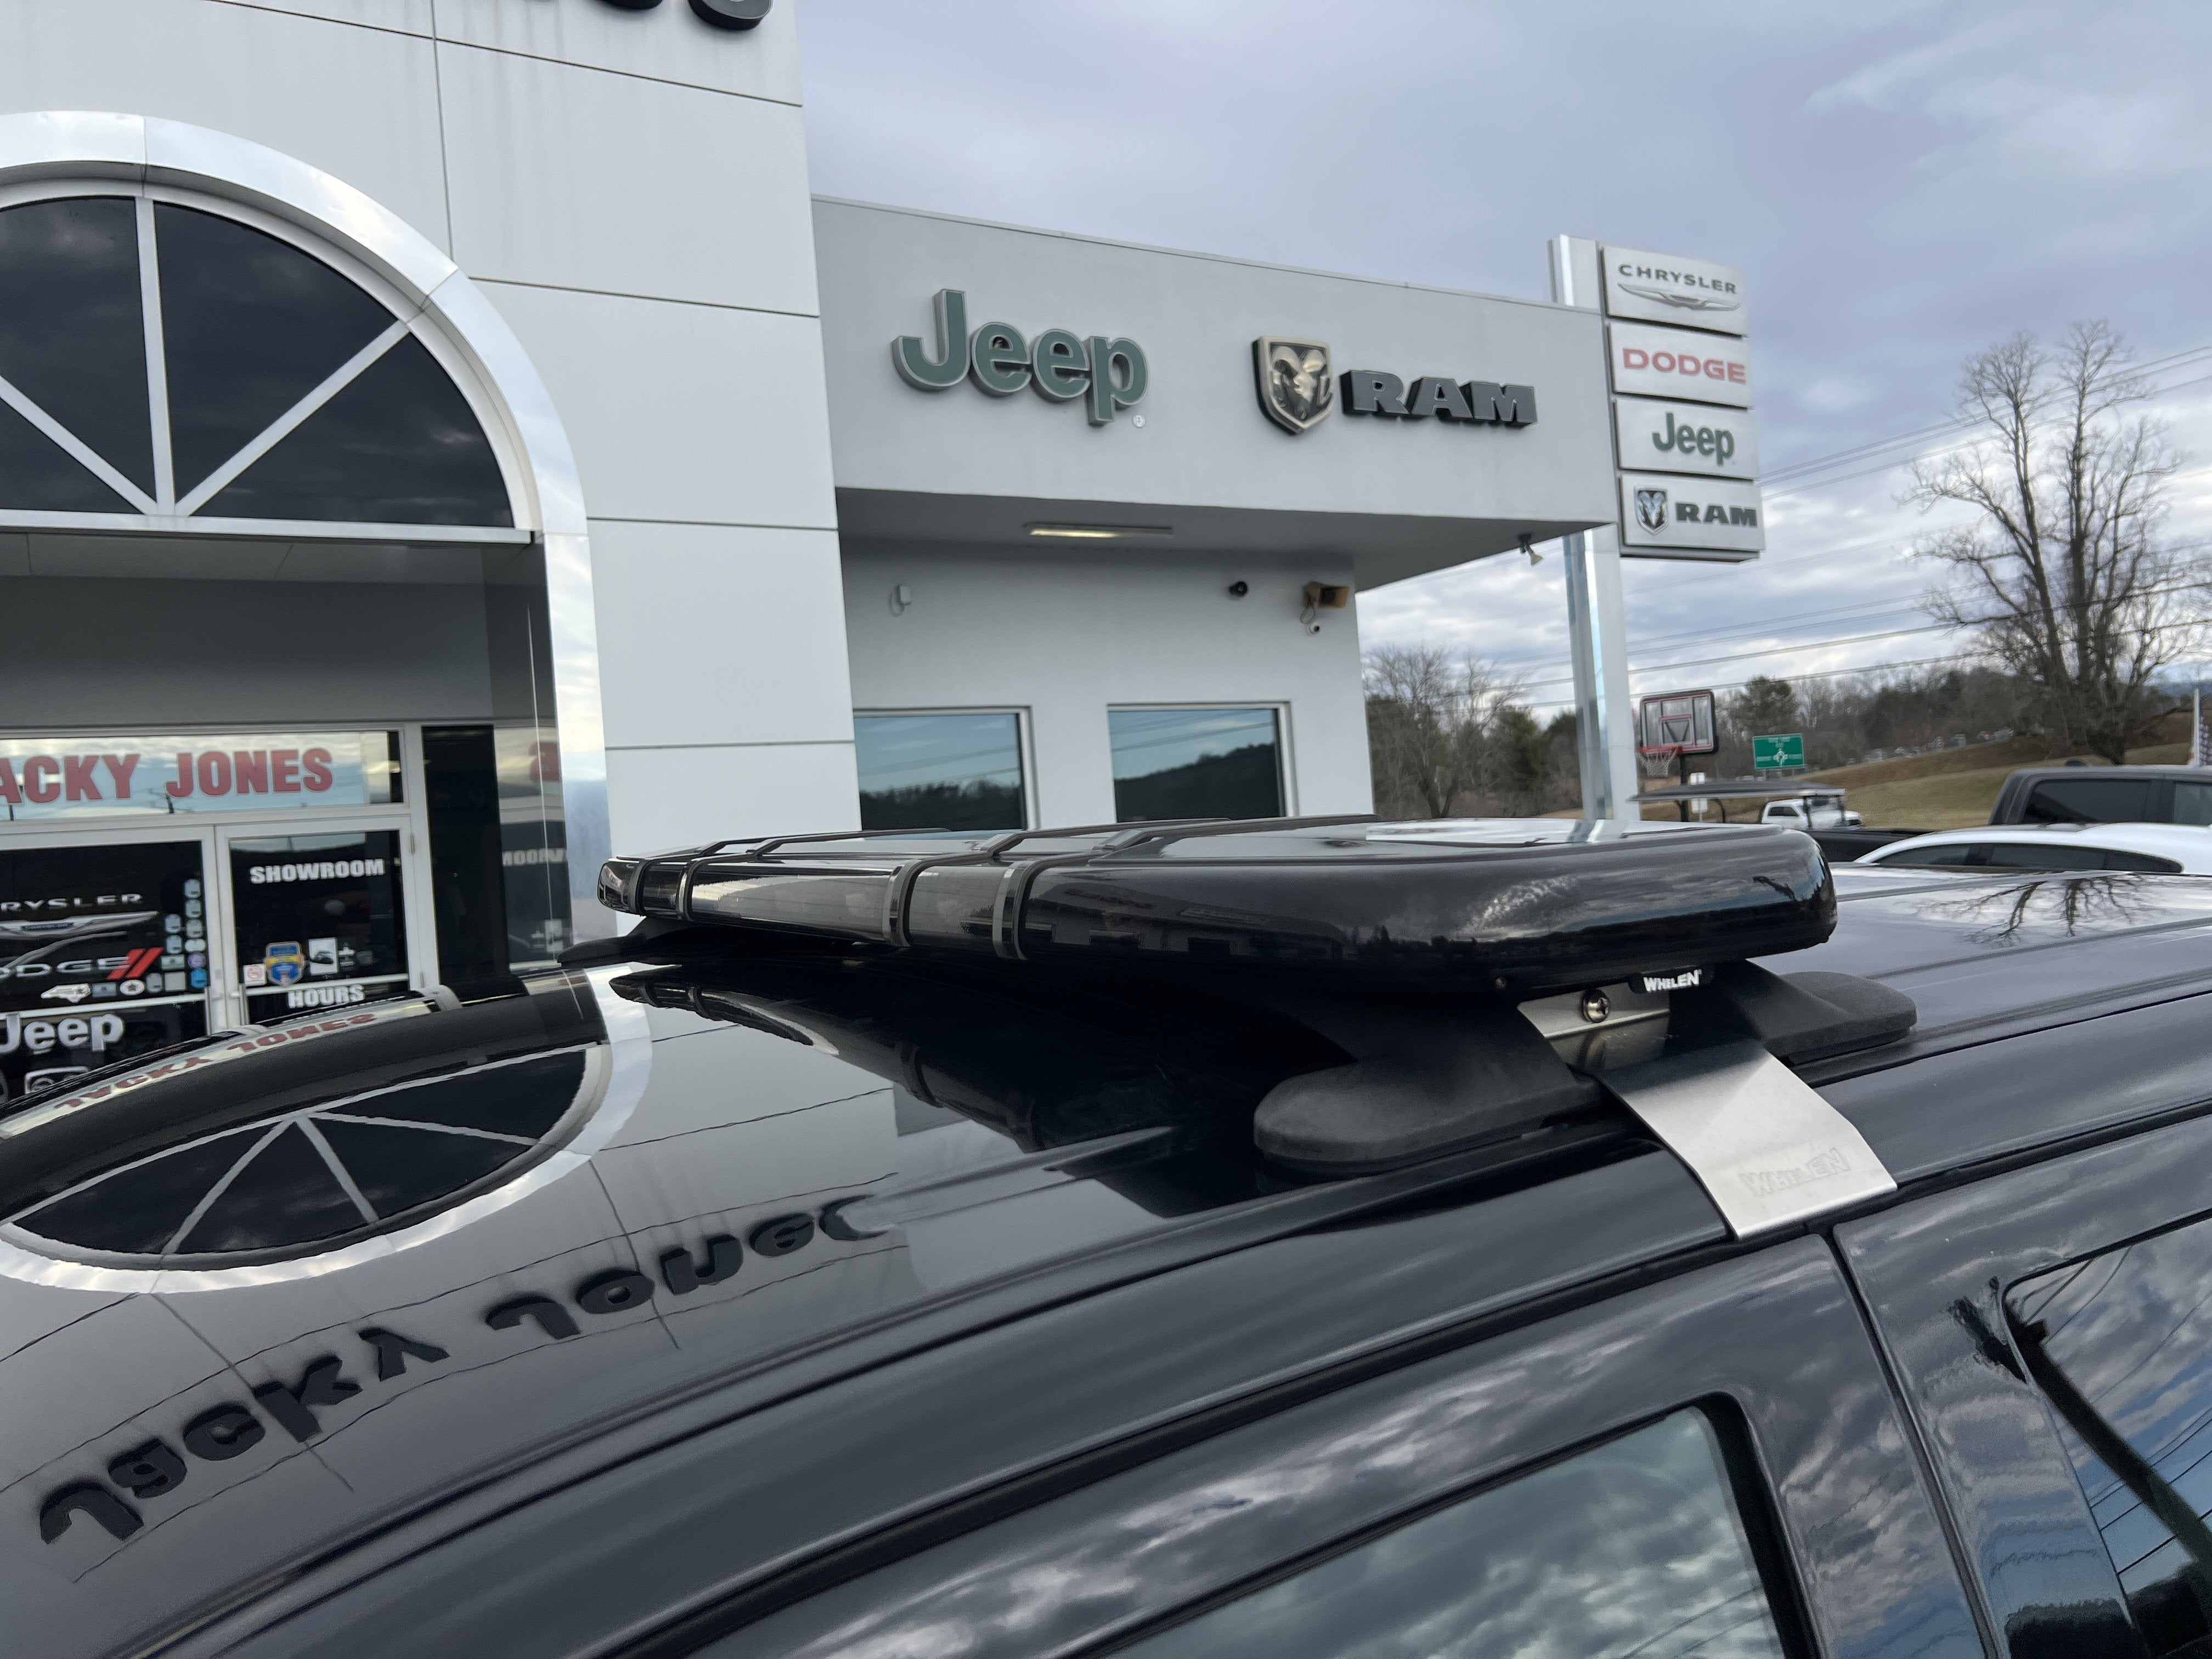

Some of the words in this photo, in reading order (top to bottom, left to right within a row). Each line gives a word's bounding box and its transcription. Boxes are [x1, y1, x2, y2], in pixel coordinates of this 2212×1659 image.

[1618, 264, 1737, 294] CHRYSLER
[891, 289, 1150, 427] Jeep
[1623, 347, 1747, 383] DODGE
[1341, 369, 1538, 427] RAM
[1651, 411, 1735, 466] Jeep
[1675, 501, 1758, 527] RAM
[166, 748, 333, 798] JONES
[250, 859, 384, 884] SHOWROOM
[288, 984, 365, 1008] HOURS
[1643, 969, 1700, 992] WHELEN
[0, 1013, 125, 1054] Jeep
